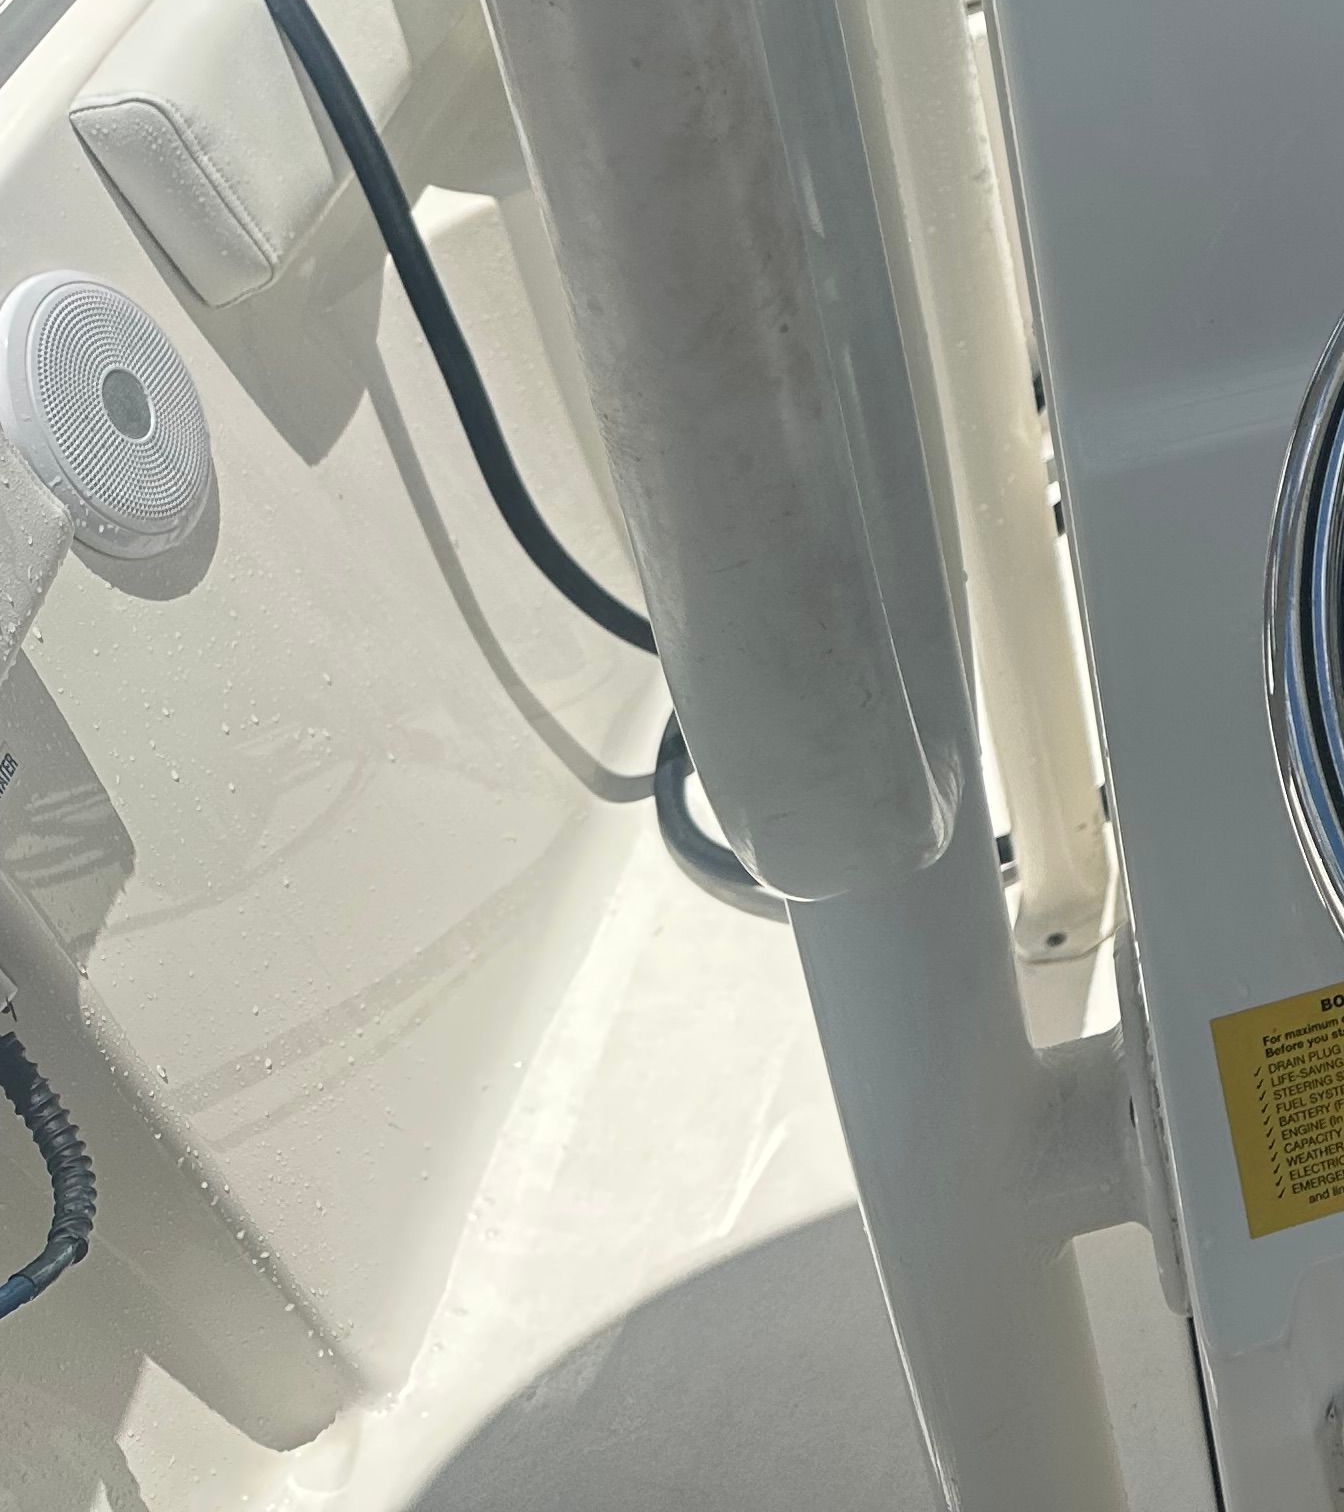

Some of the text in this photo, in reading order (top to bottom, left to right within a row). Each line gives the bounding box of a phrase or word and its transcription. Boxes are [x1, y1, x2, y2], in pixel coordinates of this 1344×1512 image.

[1262, 1034, 1282, 1046] For
[1284, 1018, 1339, 1040] maximum
[1265, 1040, 1304, 1059] Before
[1307, 1034, 1329, 1048] you
[1268, 1055, 1306, 1075] DRAIN
[1308, 1044, 1342, 1063] PLUG
[1271, 1058, 1344, 1088] LIFE-SAVING
[1272, 1075, 1333, 1101] STEERING
[1275, 1097, 1307, 1114] FUEL
[1278, 1102, 1331, 1127] BATTERY
[1281, 1118, 1328, 1141] ENGINE
[1329, 1114, 1344, 1128] (In
[1283, 1127, 1343, 1154] CAPACITY
[1285, 1142, 1344, 1168] WEATHER
[1308, 1189, 1330, 1204] and
